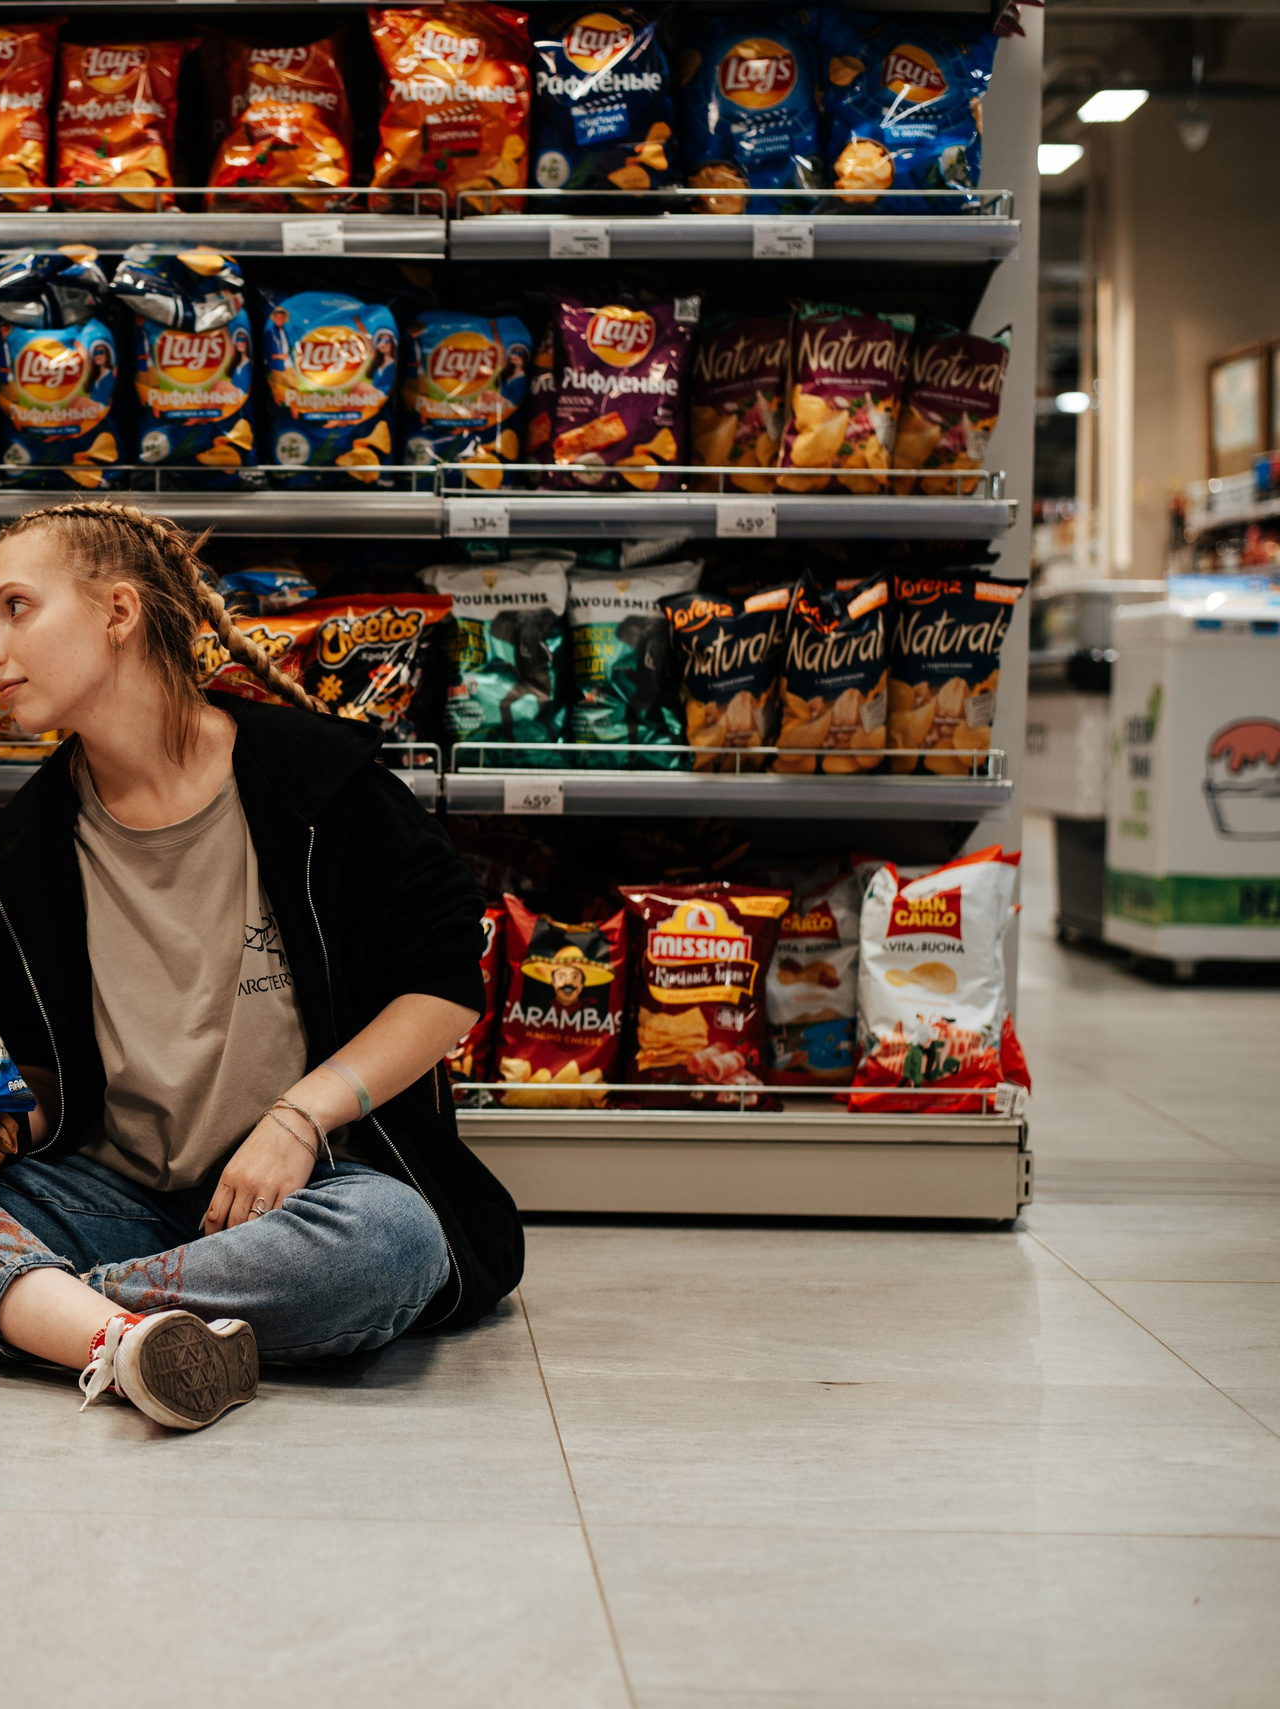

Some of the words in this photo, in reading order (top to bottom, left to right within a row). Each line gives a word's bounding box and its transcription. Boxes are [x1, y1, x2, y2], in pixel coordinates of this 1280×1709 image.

[418, 30, 479, 64] Lay's
[570, 26, 628, 60] Lay's
[87, 48, 142, 80] Lay's
[723, 55, 791, 93] Lay's
[886, 54, 942, 88] Lay's
[592, 316, 652, 352] Lay's
[161, 333, 224, 371] Lay's
[301, 341, 363, 375] Lay's
[434, 346, 494, 384] Lay's
[21, 350, 80, 388] Lay's
[913, 343, 1008, 396] Natural
[147, 386, 238, 406] Рифлёные
[284, 388, 380, 410] Рифлёные
[472, 517, 497, 530] 134
[894, 575, 962, 600] Lorenz
[321, 608, 420, 664] Cheetos
[523, 795, 552, 807] 459
[895, 909, 957, 928] CARLO
[652, 935, 745, 961] MISSION
[888, 941, 915, 953] VITA
[920, 941, 966, 954] BUONA
[237, 972, 295, 997] ARC'TERY
[525, 1030, 566, 1042] NACHO
[570, 1034, 604, 1047] CHEESE
